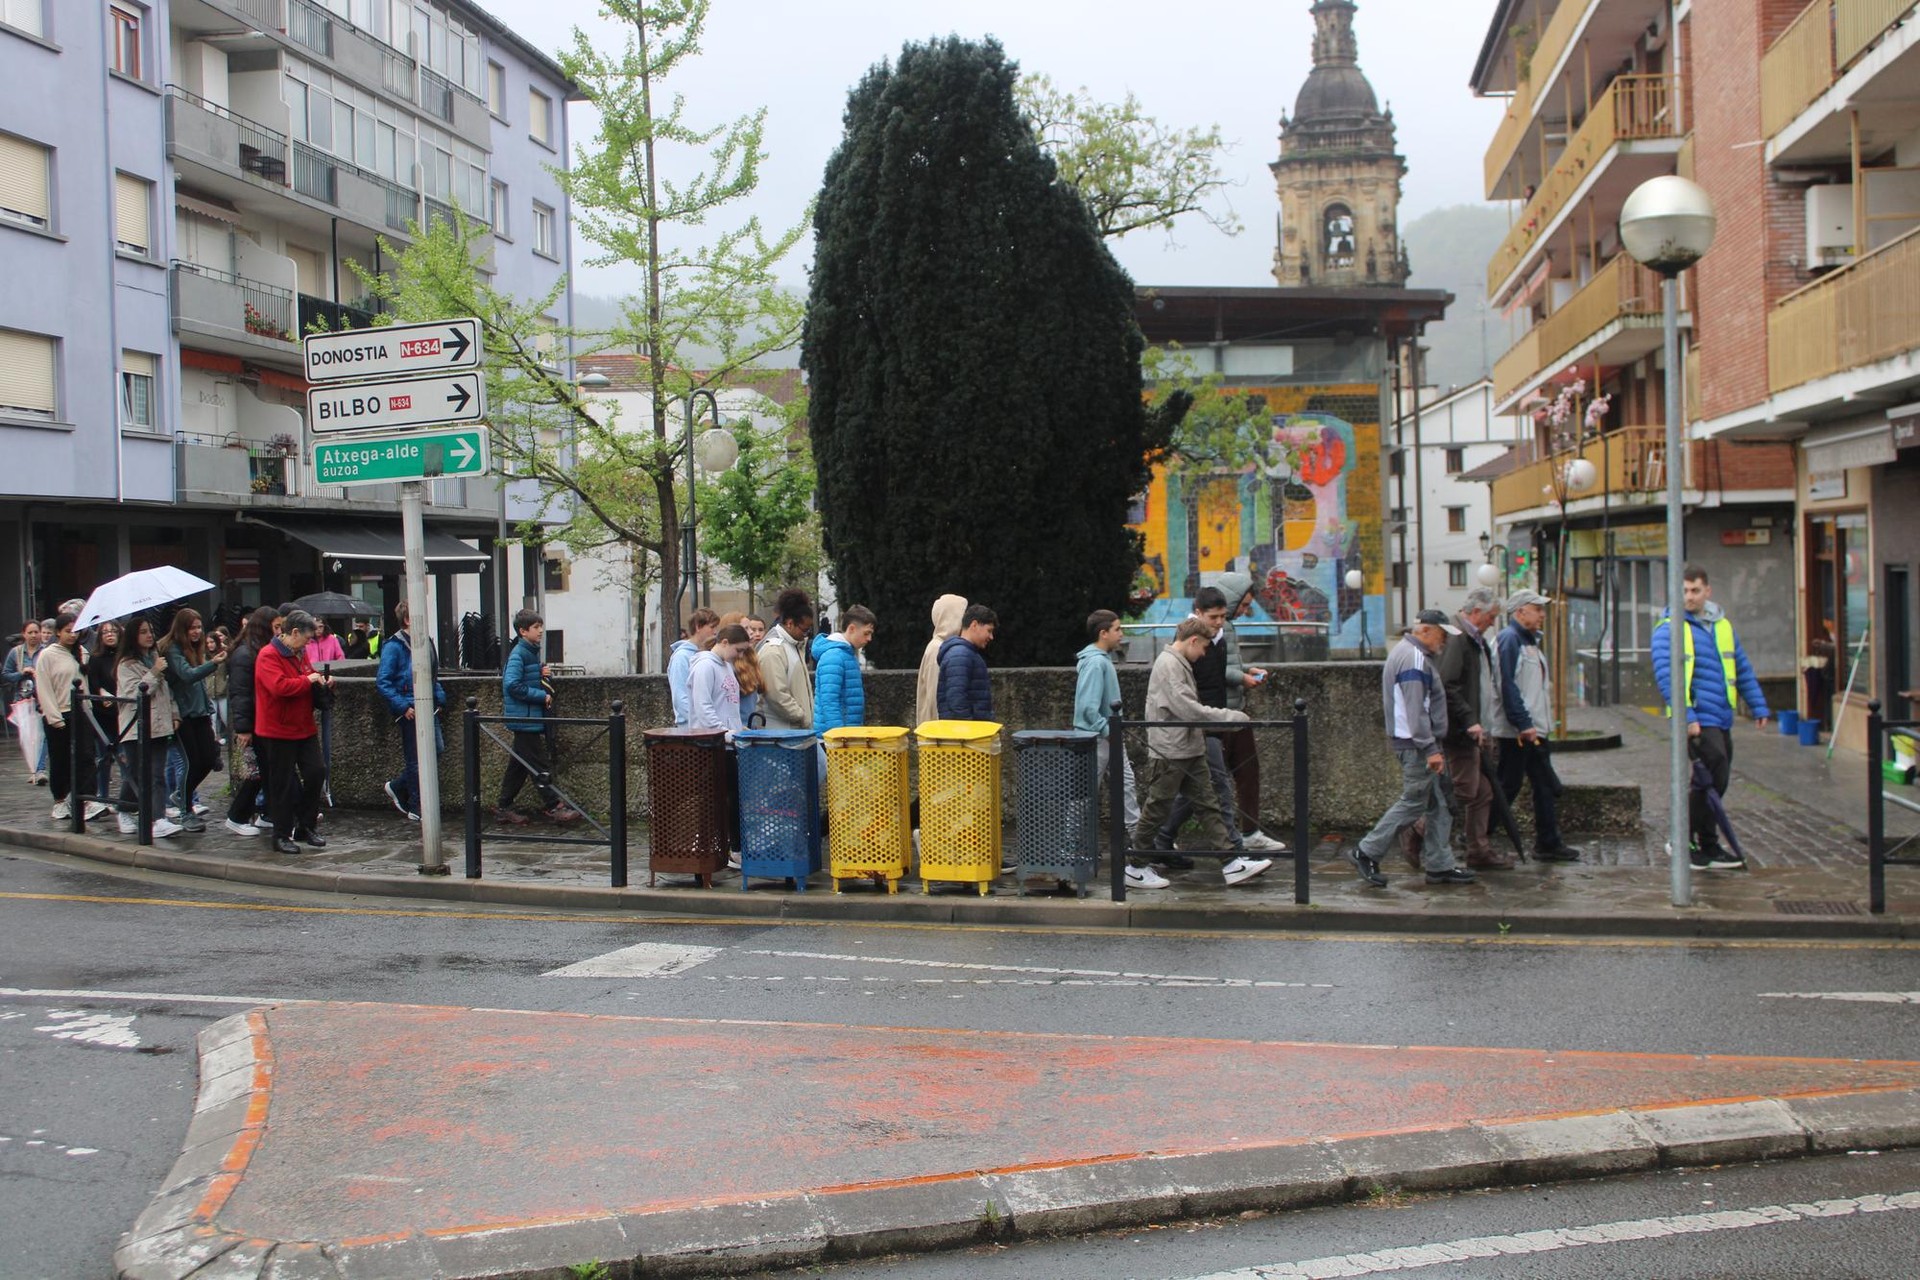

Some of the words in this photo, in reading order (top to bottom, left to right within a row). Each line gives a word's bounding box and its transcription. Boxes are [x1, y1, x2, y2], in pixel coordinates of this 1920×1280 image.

[311, 345, 388, 366] DONOSTIA
[401, 340, 440, 357] N-634
[319, 396, 381, 419] BILBO
[390, 397, 410, 409] N-634
[323, 444, 419, 467] Atxega-alde
[323, 465, 359, 477] auzoa
